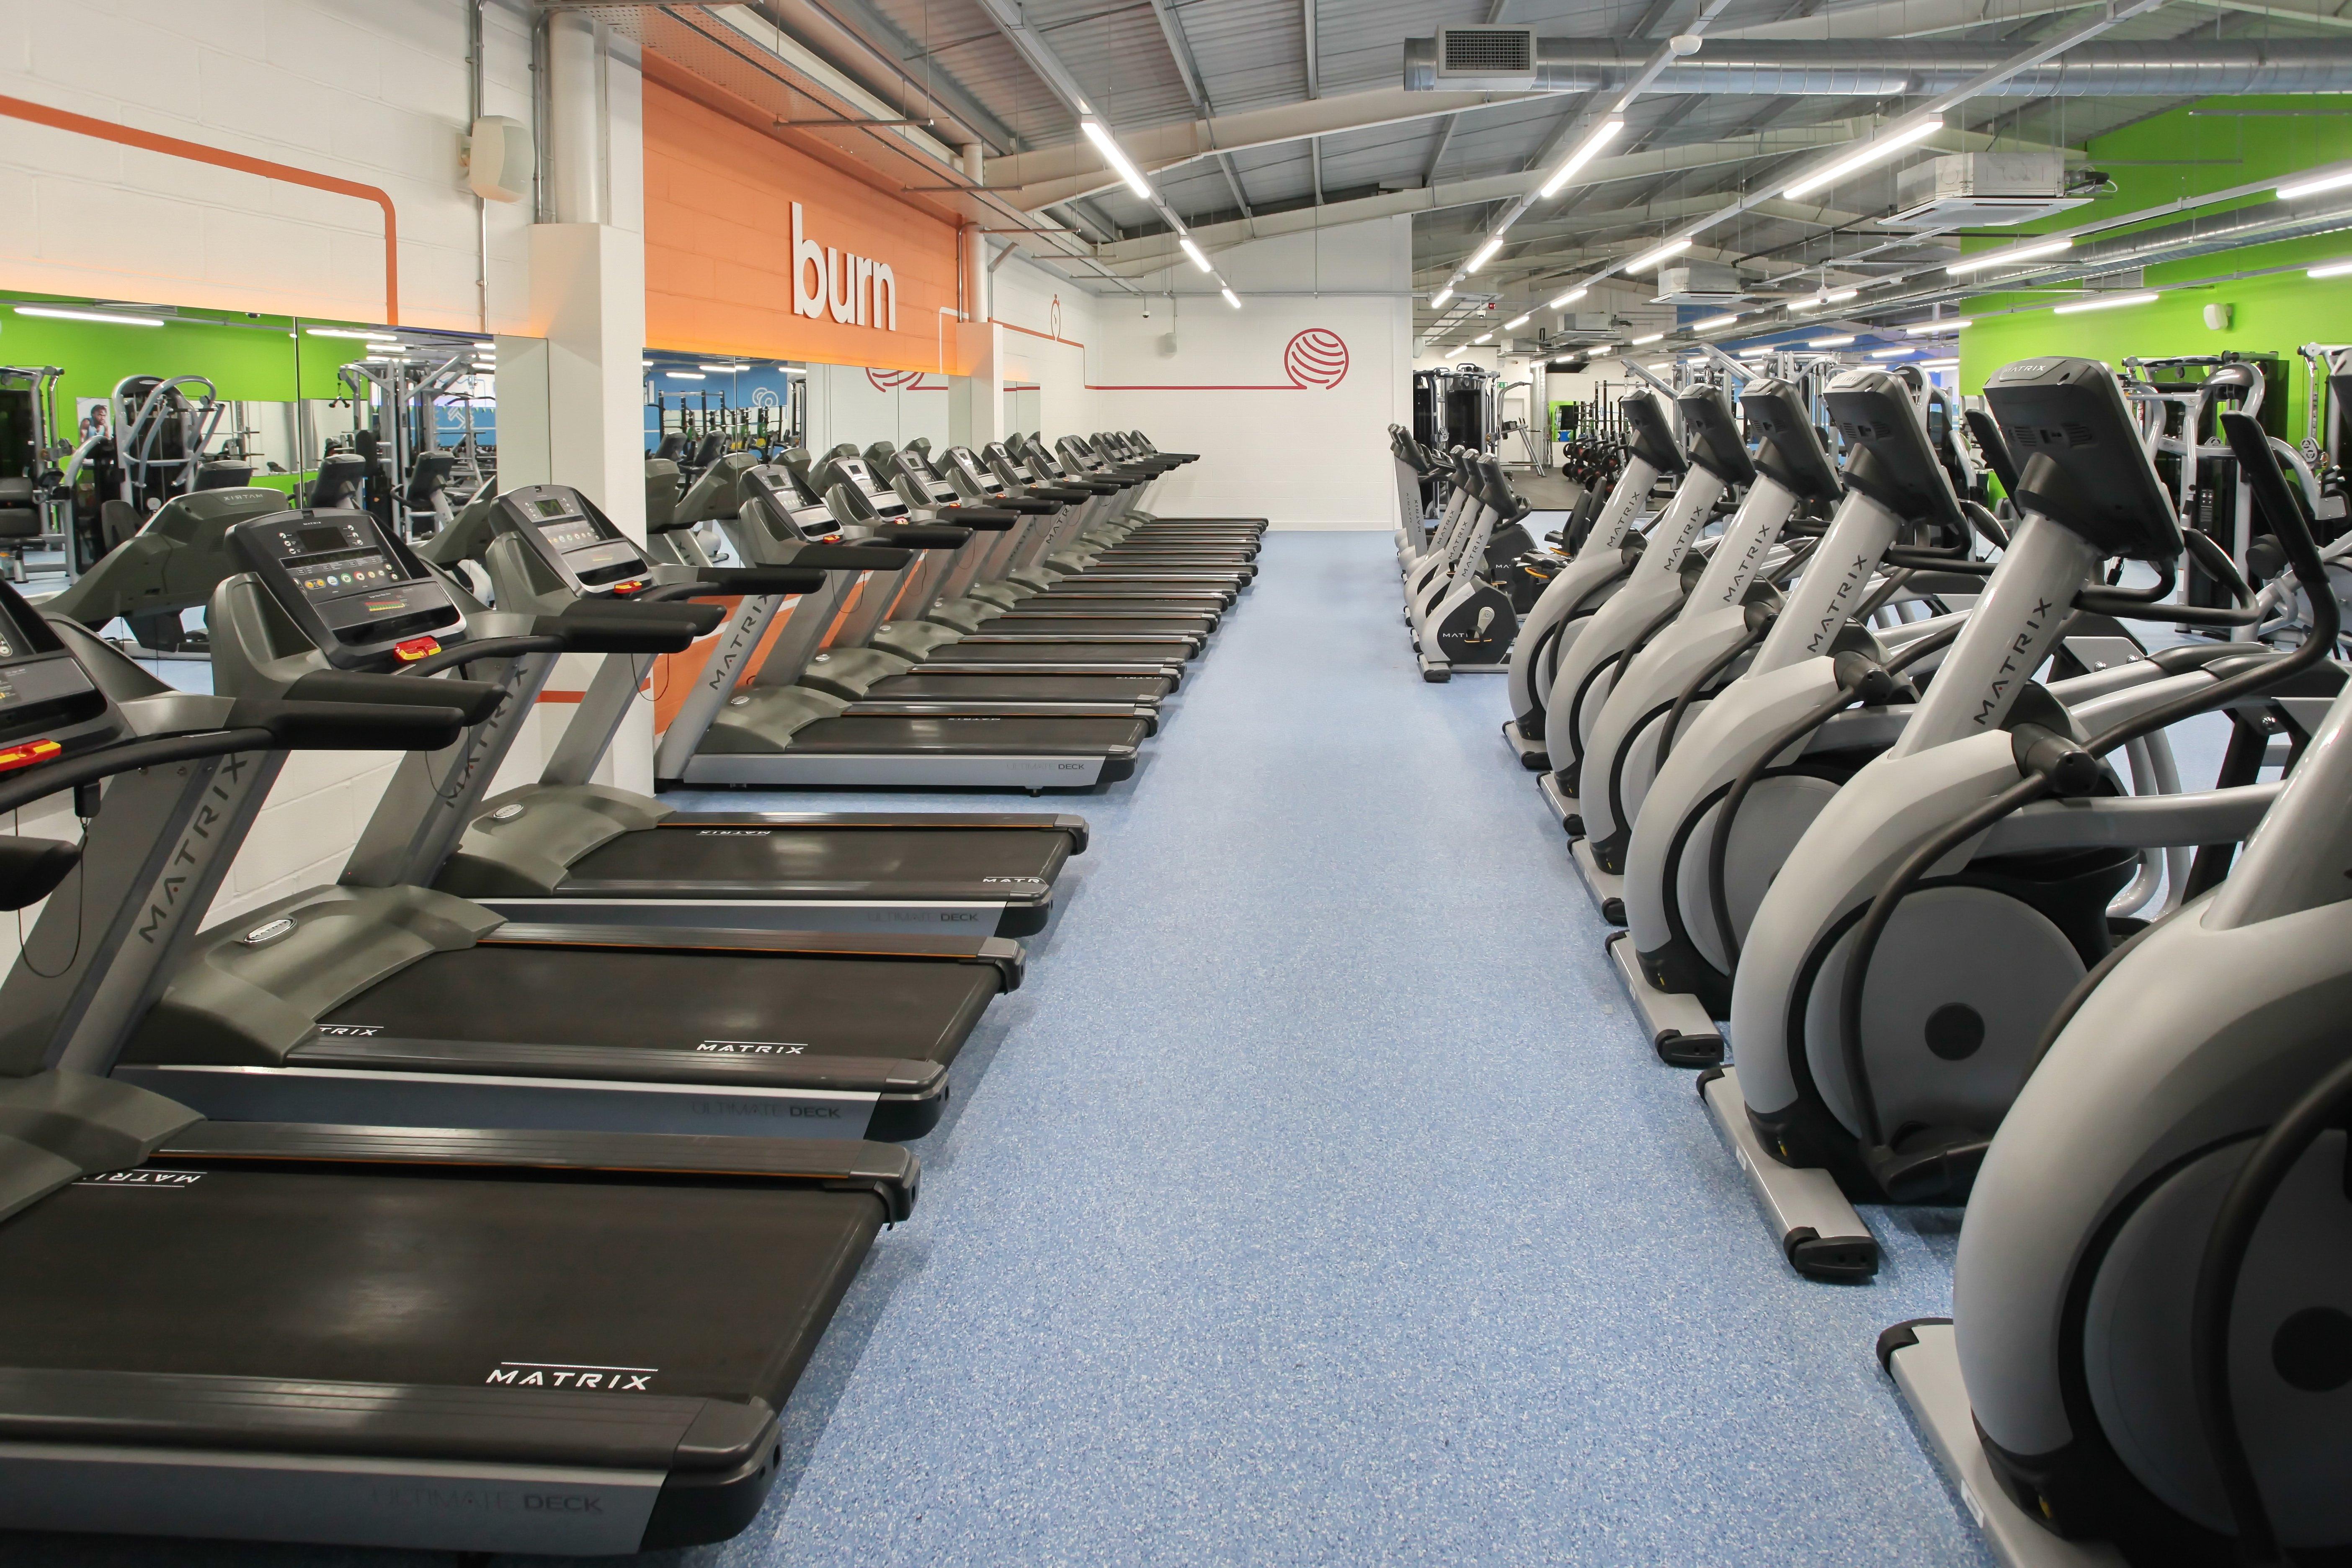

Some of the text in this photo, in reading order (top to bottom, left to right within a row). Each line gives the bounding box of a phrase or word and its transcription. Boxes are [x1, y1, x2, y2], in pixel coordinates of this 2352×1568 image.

[792, 201, 896, 331] burn
[2003, 365, 2046, 374] MATRIX
[1046, 505, 1072, 544] MATR
[1437, 510, 1455, 544] MATRIX
[1607, 492, 1640, 547] MATRIX
[1664, 506, 1703, 570] MATRIX
[1448, 521, 1468, 560] MATRIX
[1462, 533, 1483, 577] MATRIX
[1723, 524, 1770, 602] MATRIX
[1807, 554, 1867, 653] MATRIX
[709, 594, 772, 690] MATRIX
[1973, 597, 2052, 725] MATRIX
[139, 753, 248, 944] MATRIX
[941, 913, 979, 921] DECK
[320, 1027, 378, 1036] TRIX
[696, 1044, 805, 1054] MATRIX
[789, 1106, 841, 1118] DECK
[83, 1173, 201, 1183] MATRI
[485, 1369, 652, 1390] MATRIX
[523, 1493, 603, 1512] DECK
